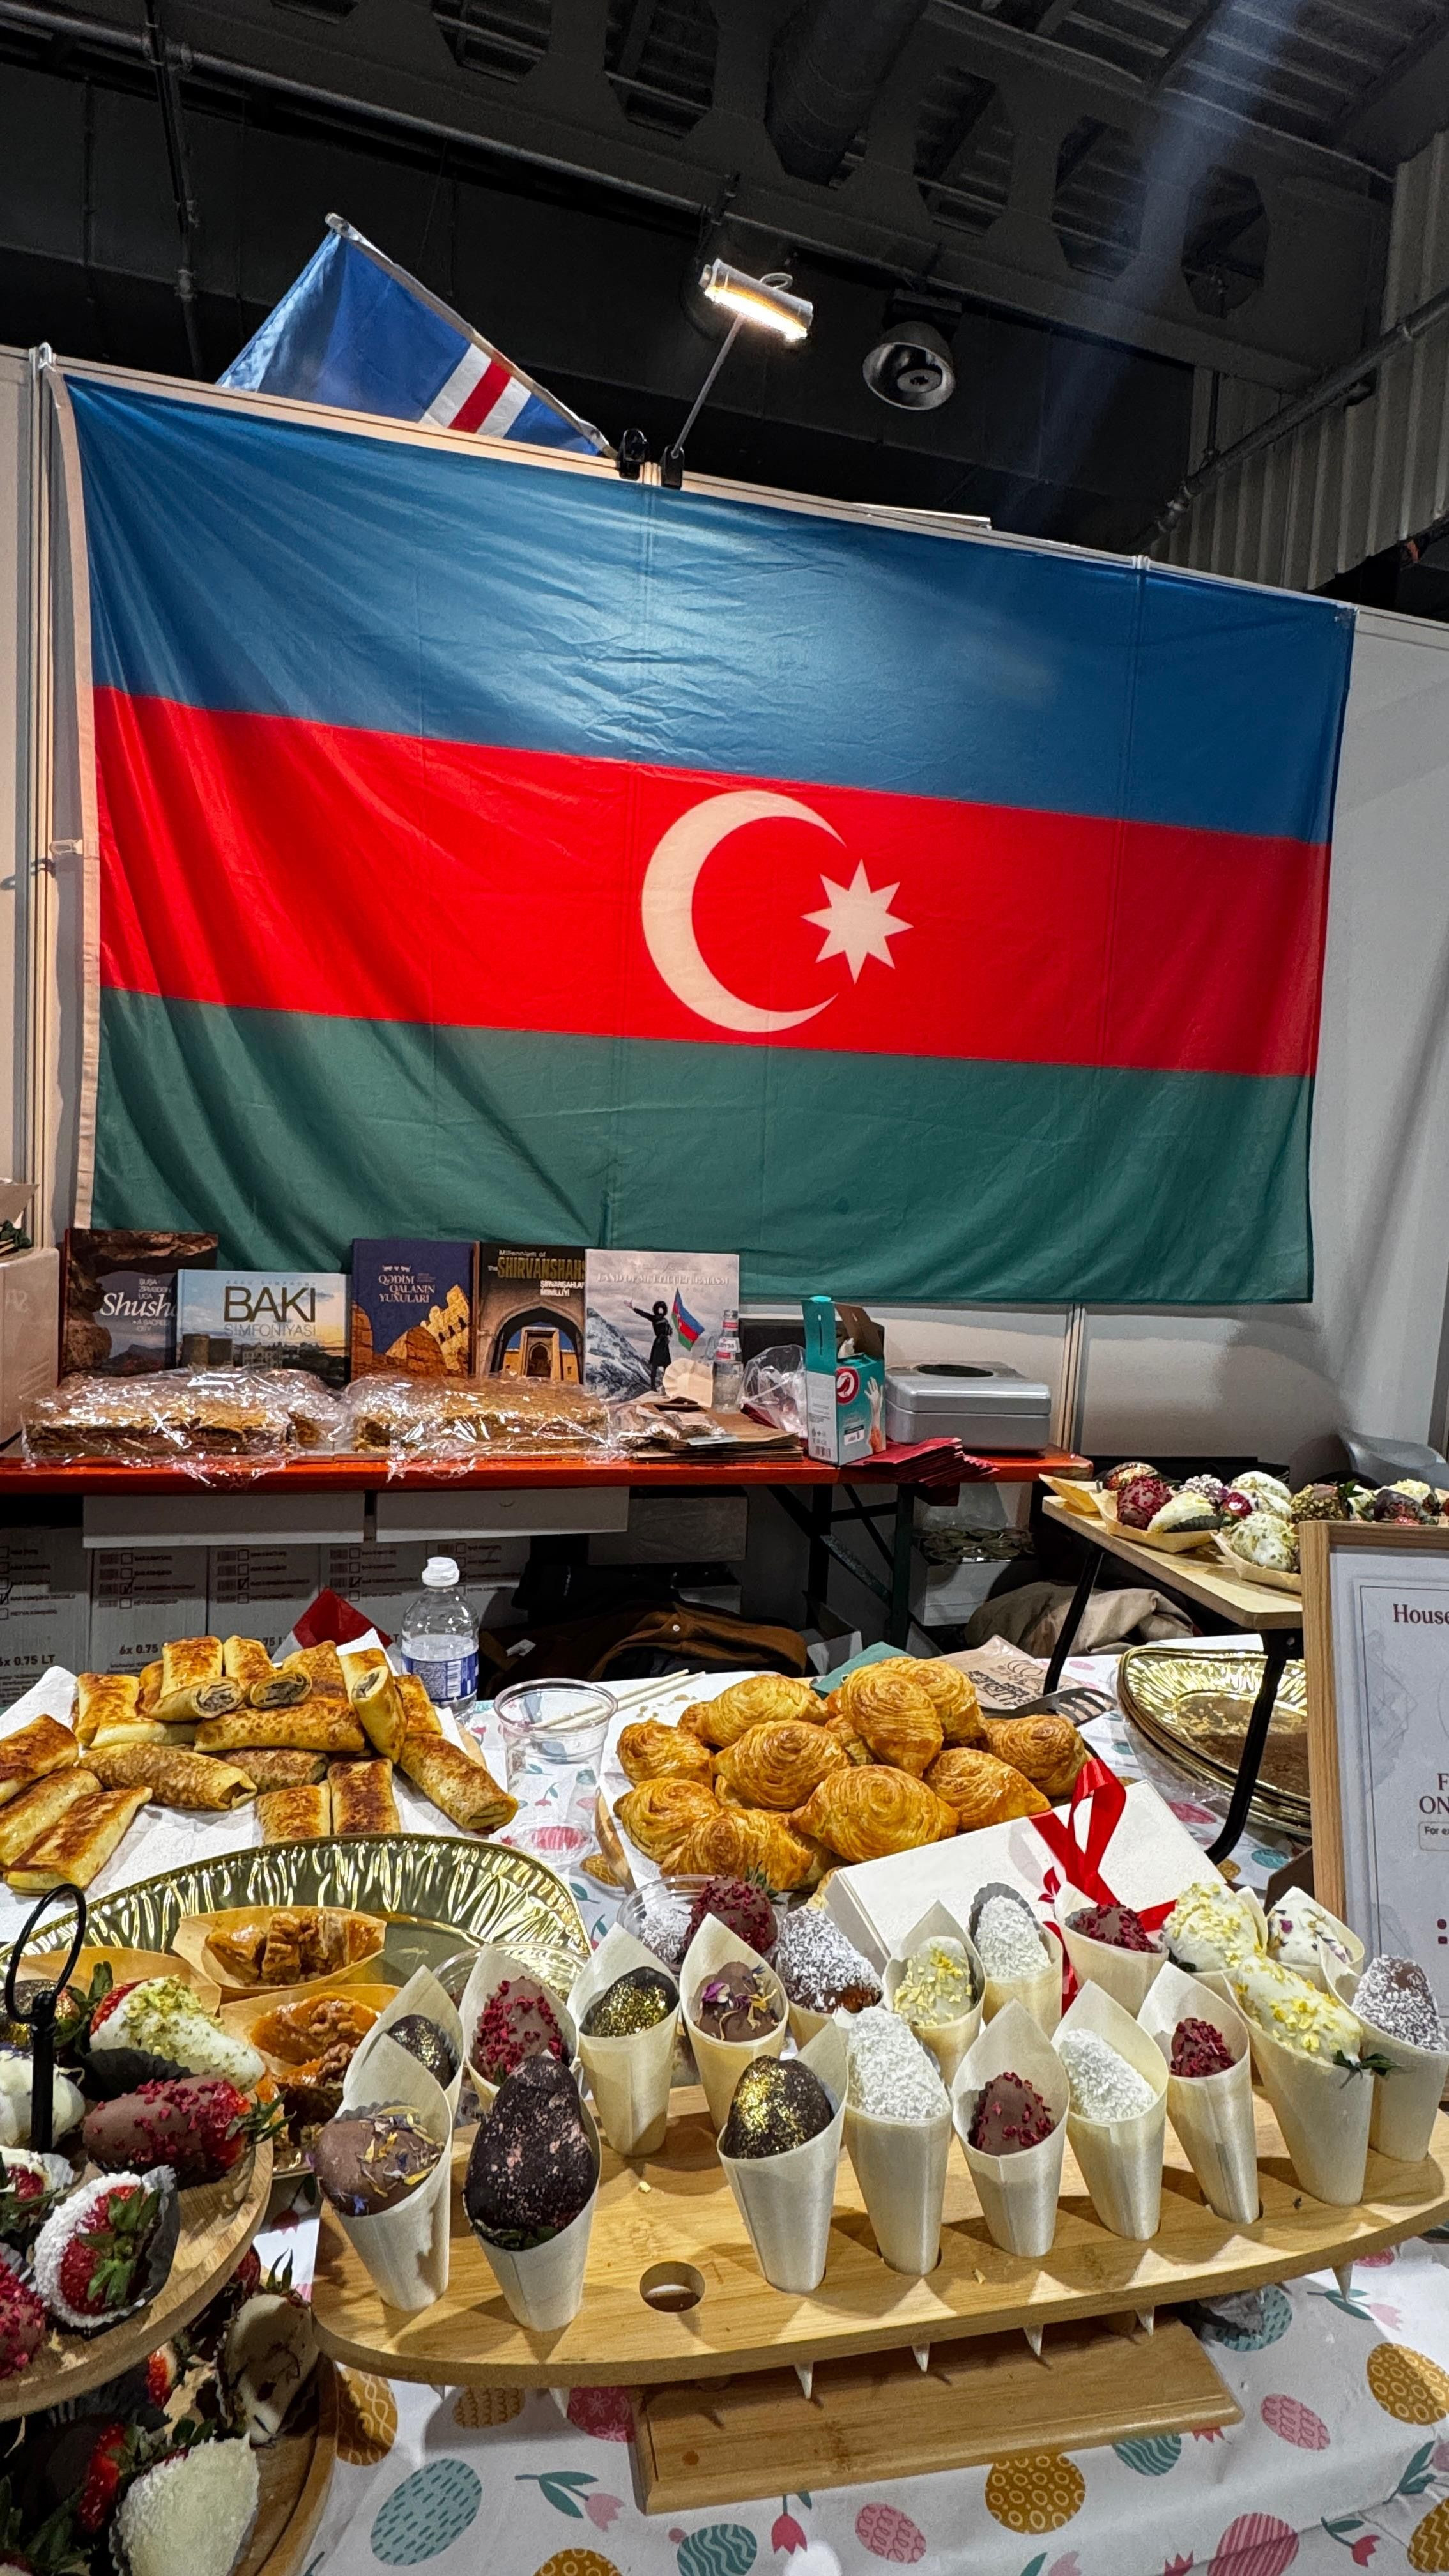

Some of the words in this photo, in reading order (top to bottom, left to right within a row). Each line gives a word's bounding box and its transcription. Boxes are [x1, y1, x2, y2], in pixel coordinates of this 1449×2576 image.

[224, 1286, 316, 1322] BAKI
[135, 1644, 158, 1653] 0.75
[13, 1655, 38, 1666] 0.75
[41, 1653, 56, 1664] LT
[1425, 1826, 1439, 1835] For
